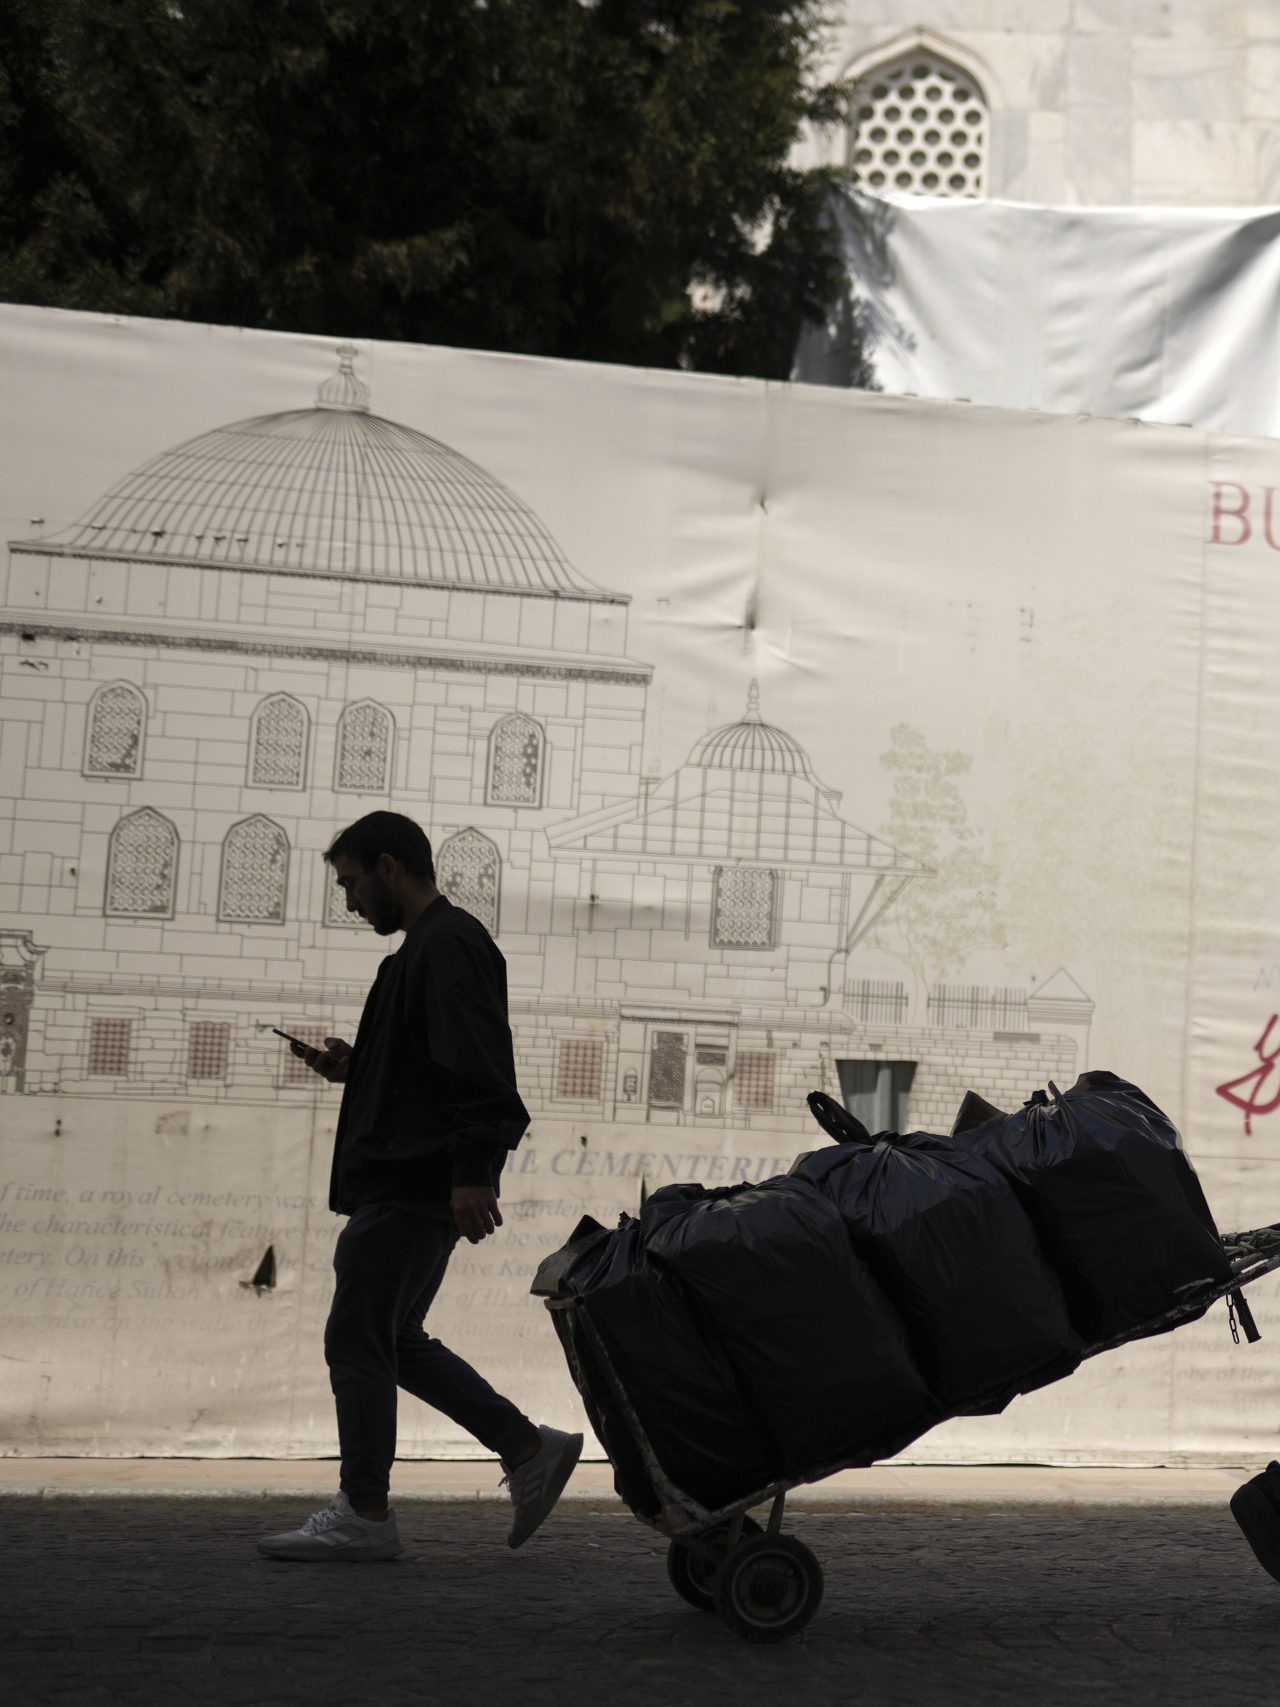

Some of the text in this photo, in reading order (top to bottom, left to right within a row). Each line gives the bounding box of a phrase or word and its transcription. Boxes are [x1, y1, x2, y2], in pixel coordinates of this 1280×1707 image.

[550, 1148, 795, 1184] CEMENTERIE
[15, 1183, 70, 1204] time,
[79, 1189, 95, 1203] a
[102, 1185, 162, 1210] royal
[166, 1189, 268, 1212] cemetery
[0, 1213, 27, 1234] he
[65, 1248, 99, 1267] On
[105, 1249, 145, 1268] this
